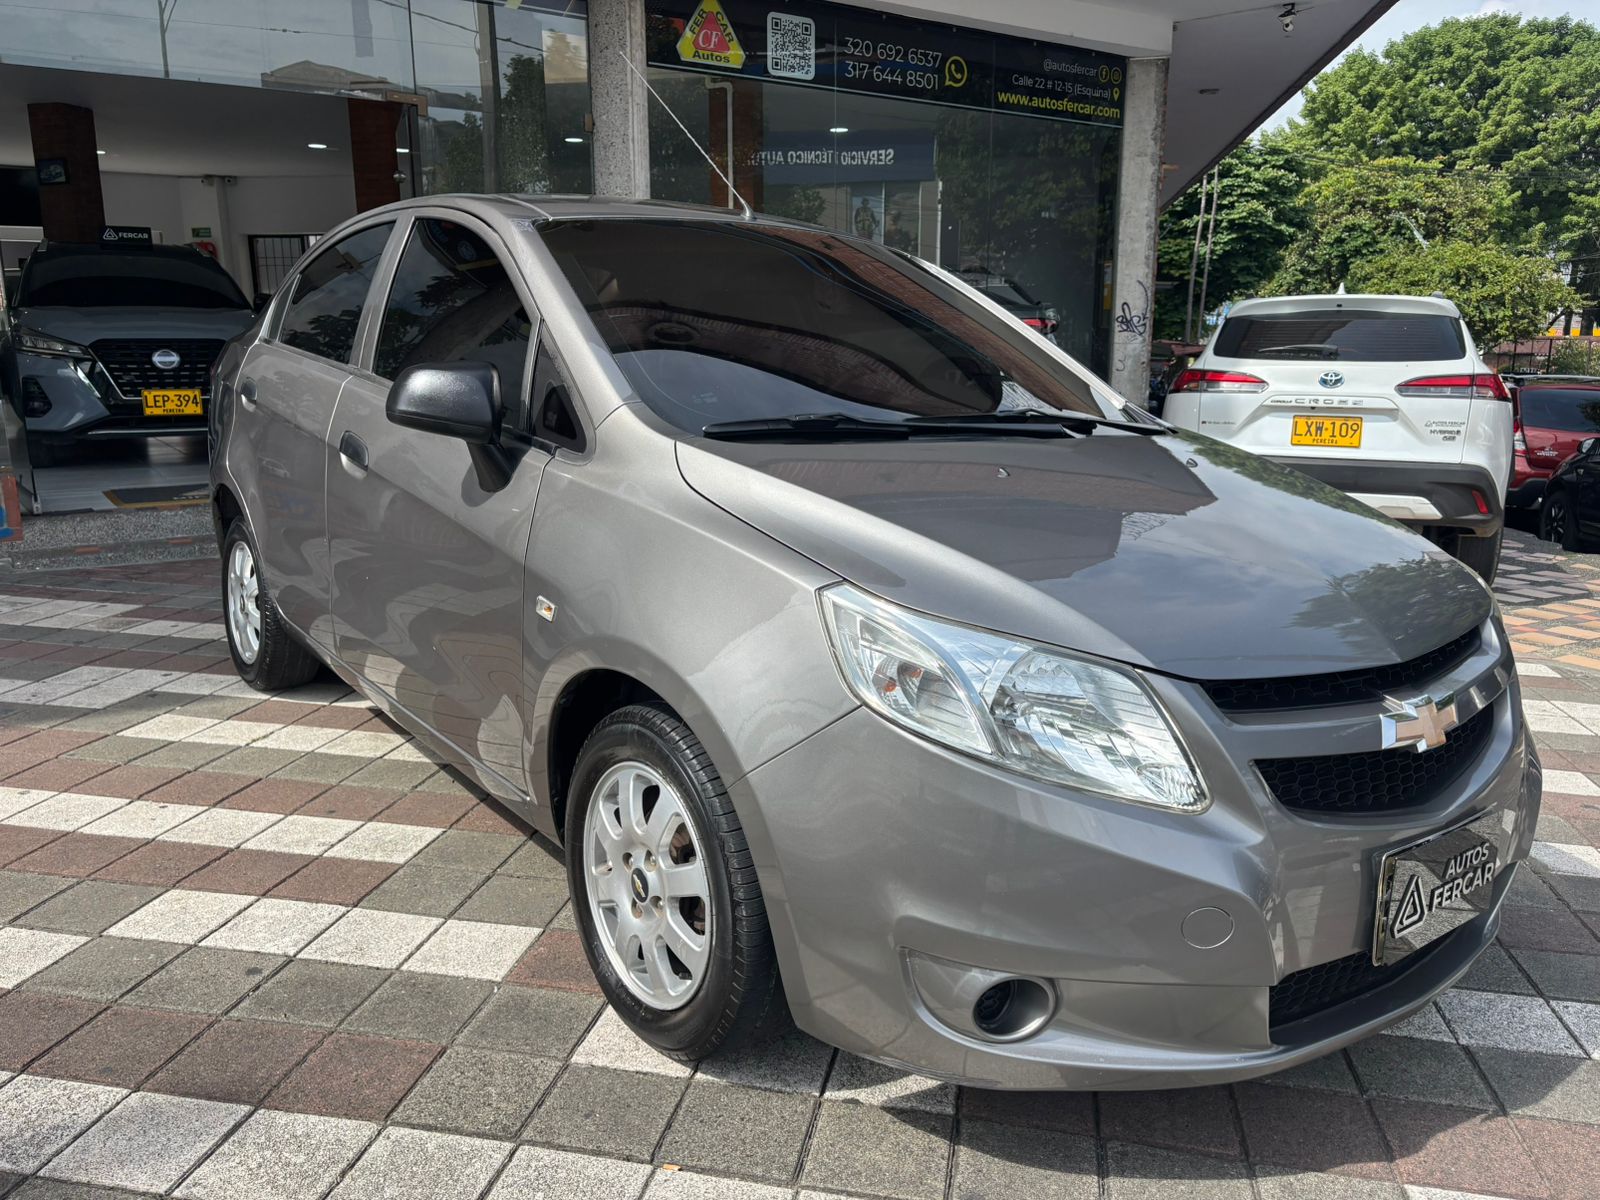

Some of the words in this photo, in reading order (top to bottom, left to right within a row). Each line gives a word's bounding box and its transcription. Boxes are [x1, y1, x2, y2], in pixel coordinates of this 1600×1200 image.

[689, 8, 709, 36] FER
[715, 10, 735, 44] CAR
[698, 29, 721, 49] CF
[844, 36, 873, 58] 320
[876, 43, 904, 63] 692
[908, 48, 942, 68] 6537
[692, 50, 731, 64] Autos
[1043, 58, 1098, 77] @autosfercar
[844, 60, 869, 80] 317
[873, 65, 903, 85] 644
[906, 70, 939, 90] 8501
[1012, 73, 1034, 88] Calle
[1034, 78, 1046, 90] 22
[1046, 80, 1053, 90] #
[1054, 80, 1073, 93] 12-15
[1074, 84, 1111, 101] (Esquina)
[997, 90, 1121, 119] www.autosfercar.com
[118, 231, 149, 239] FERCAR
[1445, 841, 1490, 879] AUTOS
[1431, 862, 1495, 913] FERCAR
